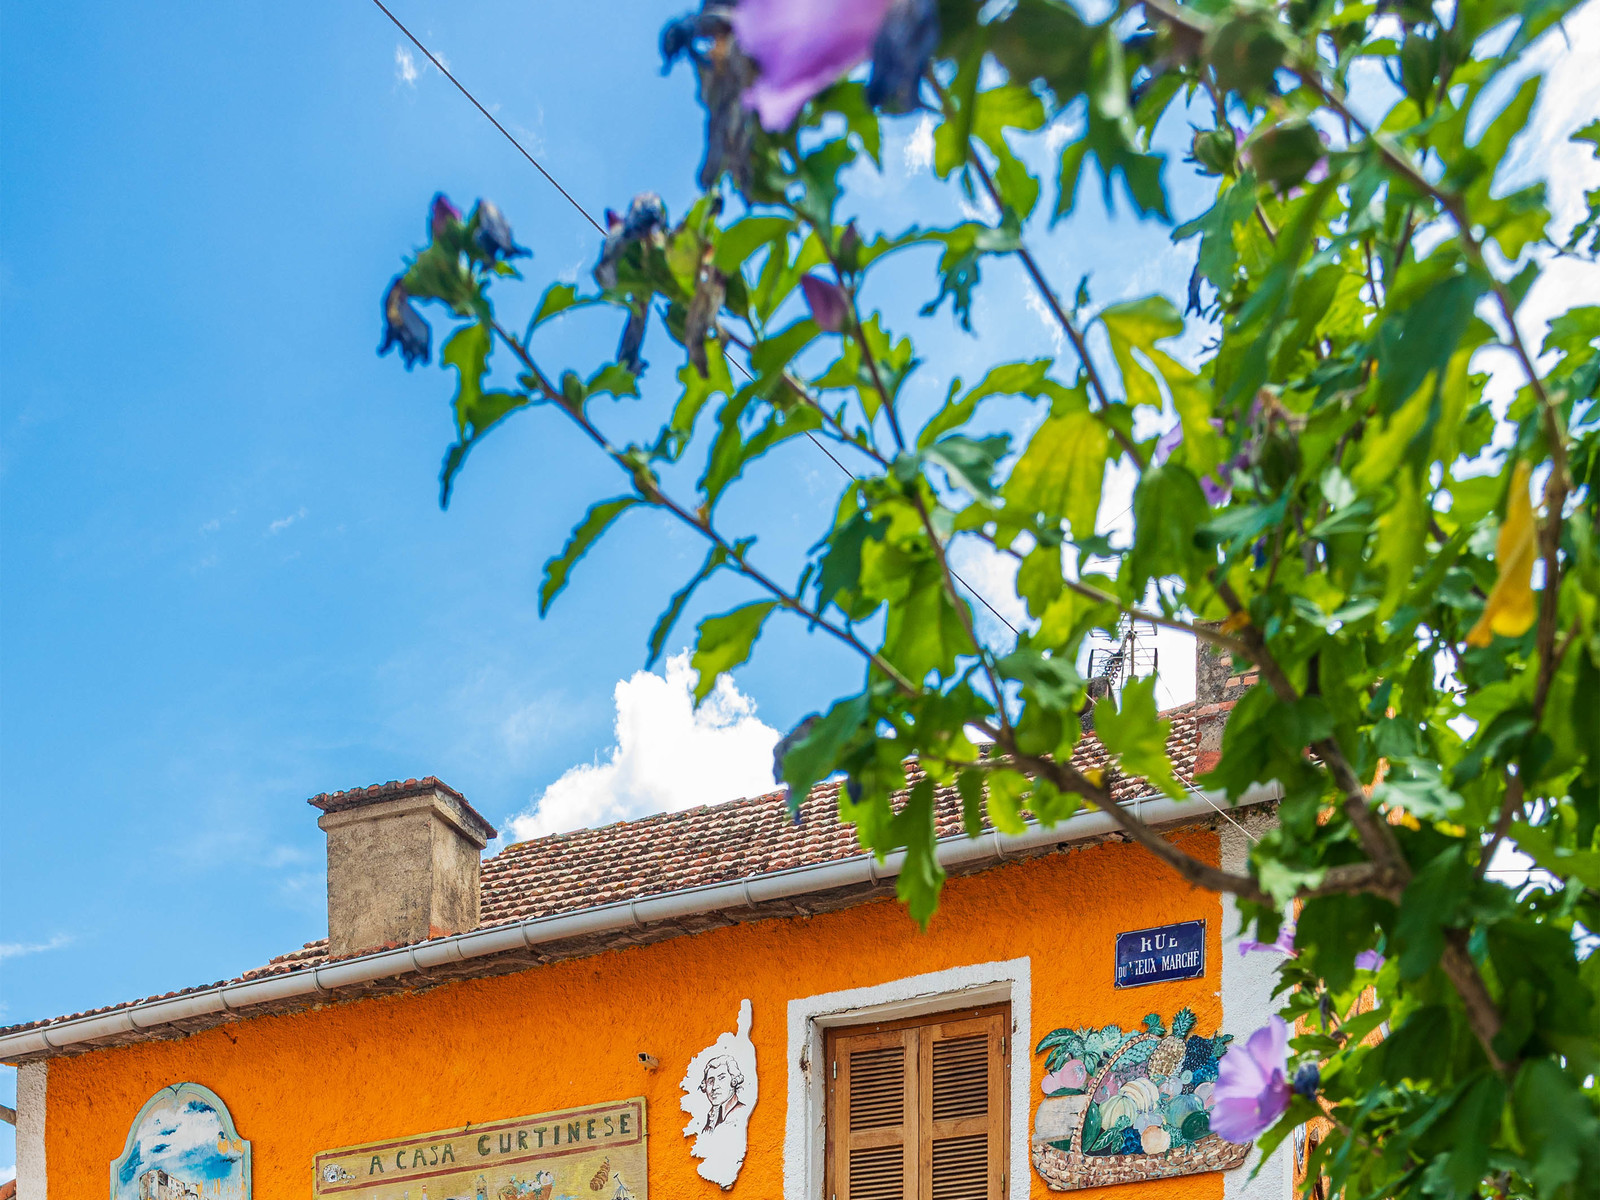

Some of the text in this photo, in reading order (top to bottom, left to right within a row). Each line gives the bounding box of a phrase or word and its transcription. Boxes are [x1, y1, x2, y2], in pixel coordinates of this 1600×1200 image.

[1161, 948, 1200, 971] MARCHÉ
[369, 1113, 631, 1175] A CASA CURTINESE
